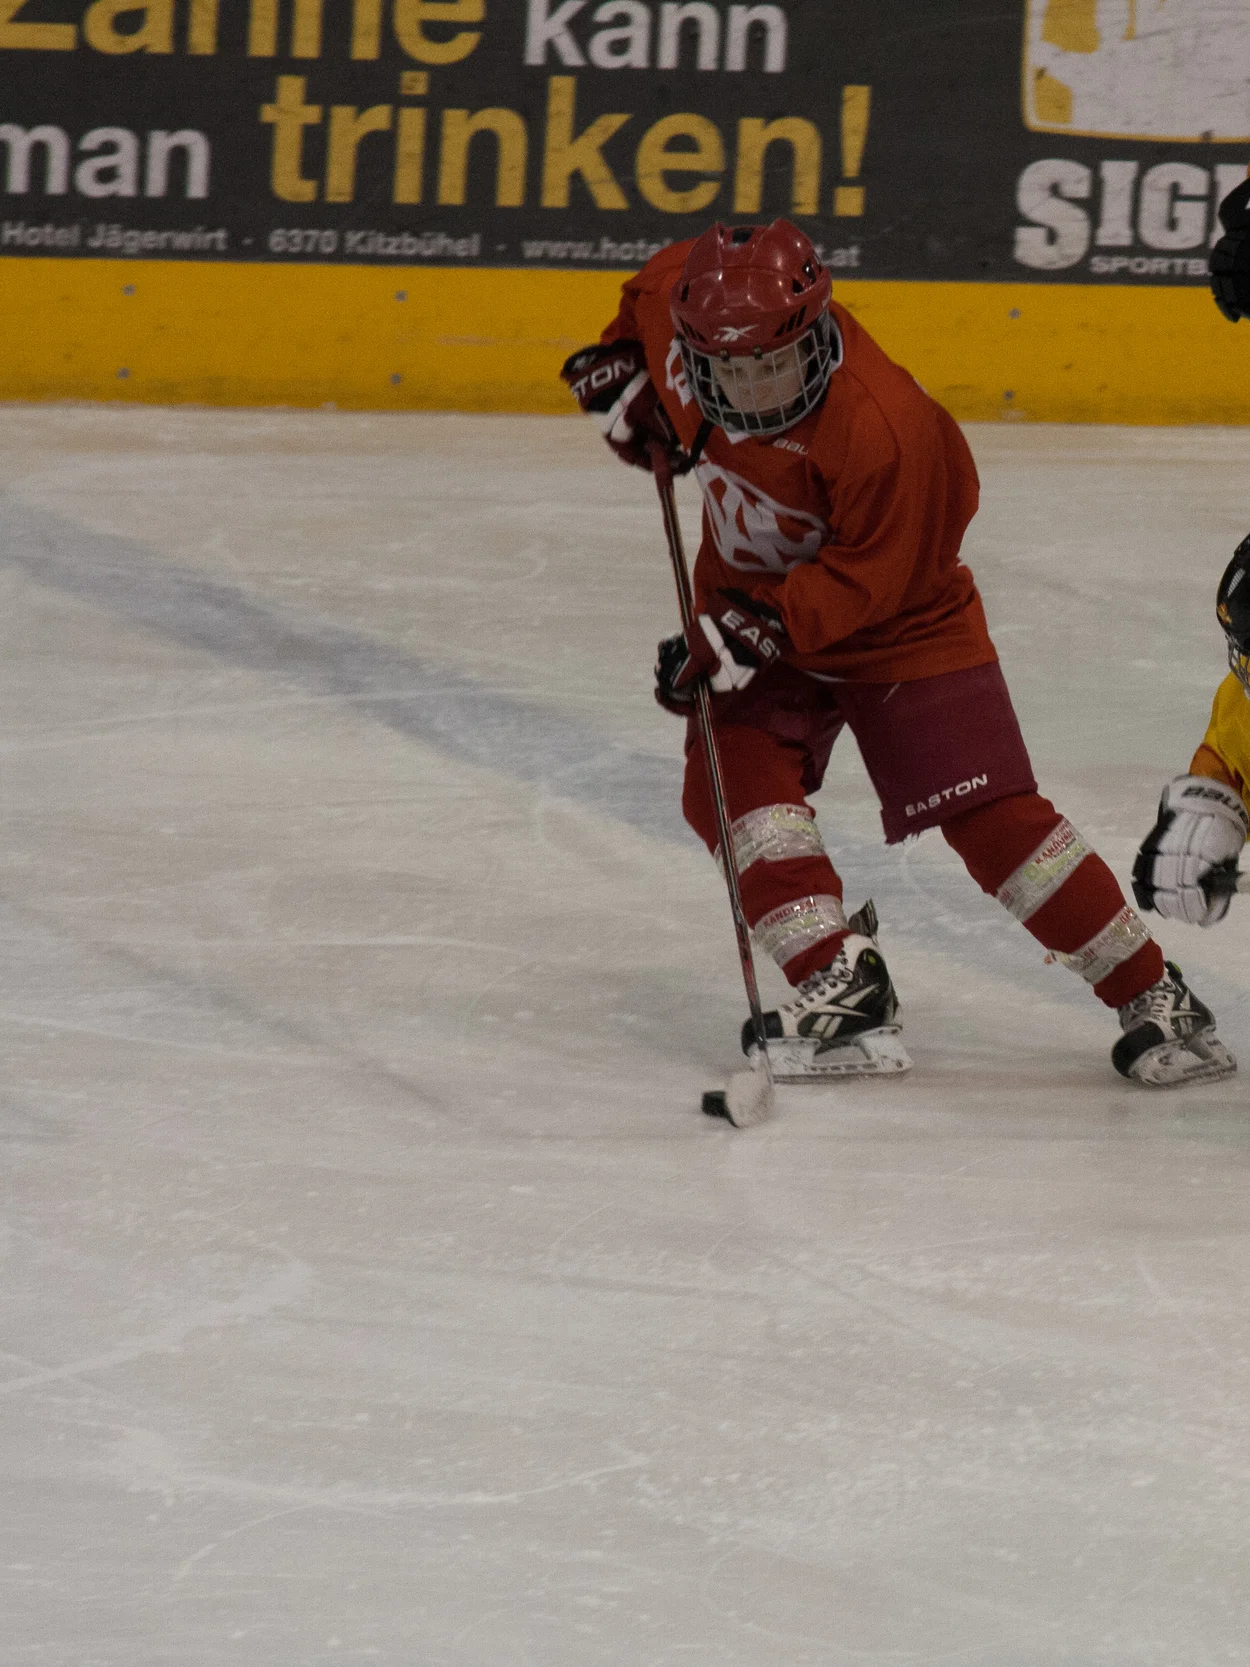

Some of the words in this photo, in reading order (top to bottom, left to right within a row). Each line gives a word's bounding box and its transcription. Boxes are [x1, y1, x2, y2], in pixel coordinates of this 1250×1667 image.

[524, 0, 788, 74] kann
[0, 122, 210, 200] man
[260, 72, 872, 217] trinken!
[2, 221, 81, 246] Hotel
[87, 223, 229, 255] Jägerwirt
[268, 228, 338, 254] 6370
[344, 230, 481, 257] Kitzbühel
[1090, 254, 1214, 278] SPORTB
[720, 608, 781, 661] EAS
[905, 773, 988, 818] EASTON
